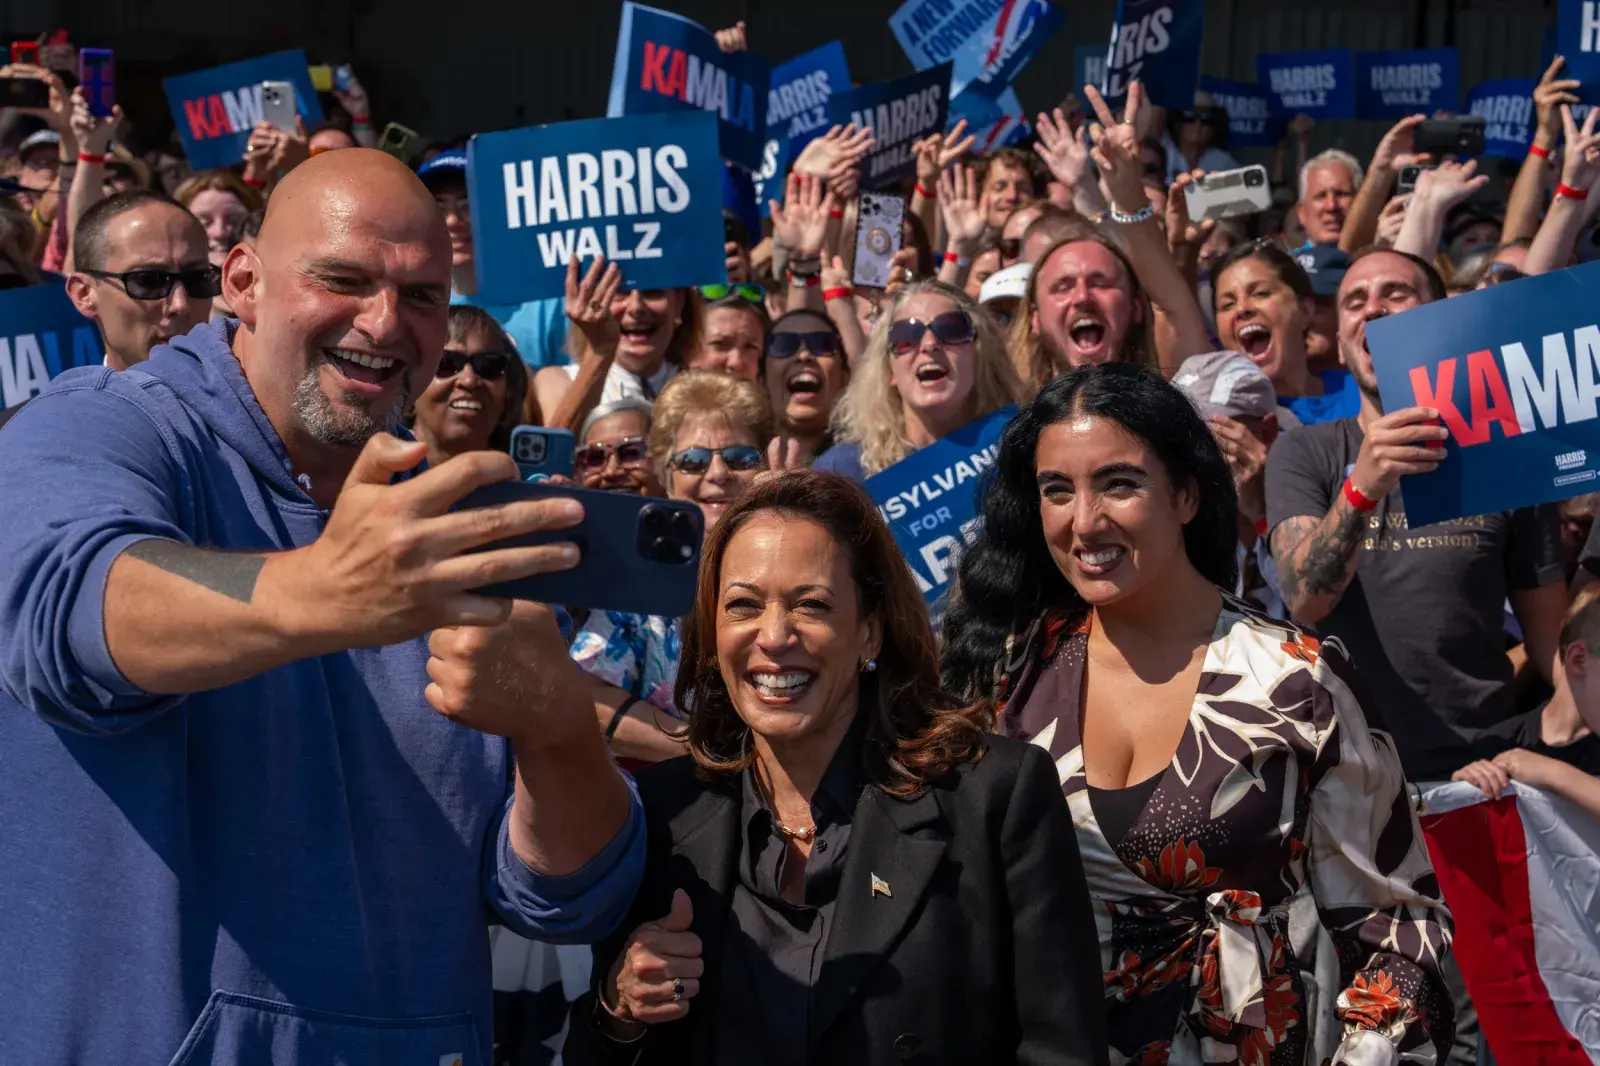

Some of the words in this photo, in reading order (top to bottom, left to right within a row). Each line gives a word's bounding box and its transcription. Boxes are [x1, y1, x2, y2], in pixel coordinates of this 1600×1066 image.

[902, 20, 922, 47] A
[641, 40, 755, 132] KAMALA
[1269, 63, 1337, 93] HARRIS
[1370, 63, 1442, 92] HARRIS
[766, 69, 832, 127] ARRIS
[1281, 88, 1328, 109] WALZ
[1381, 89, 1431, 106] WALZ
[1470, 94, 1533, 125] HARRI
[788, 105, 829, 138] ALZ
[869, 135, 926, 178] WAL
[502, 144, 690, 229] HARRIS
[536, 221, 663, 268] WALZ
[1409, 325, 1600, 448] KAMA
[1555, 449, 1587, 466] HARRIS
[909, 506, 954, 537] FOR
